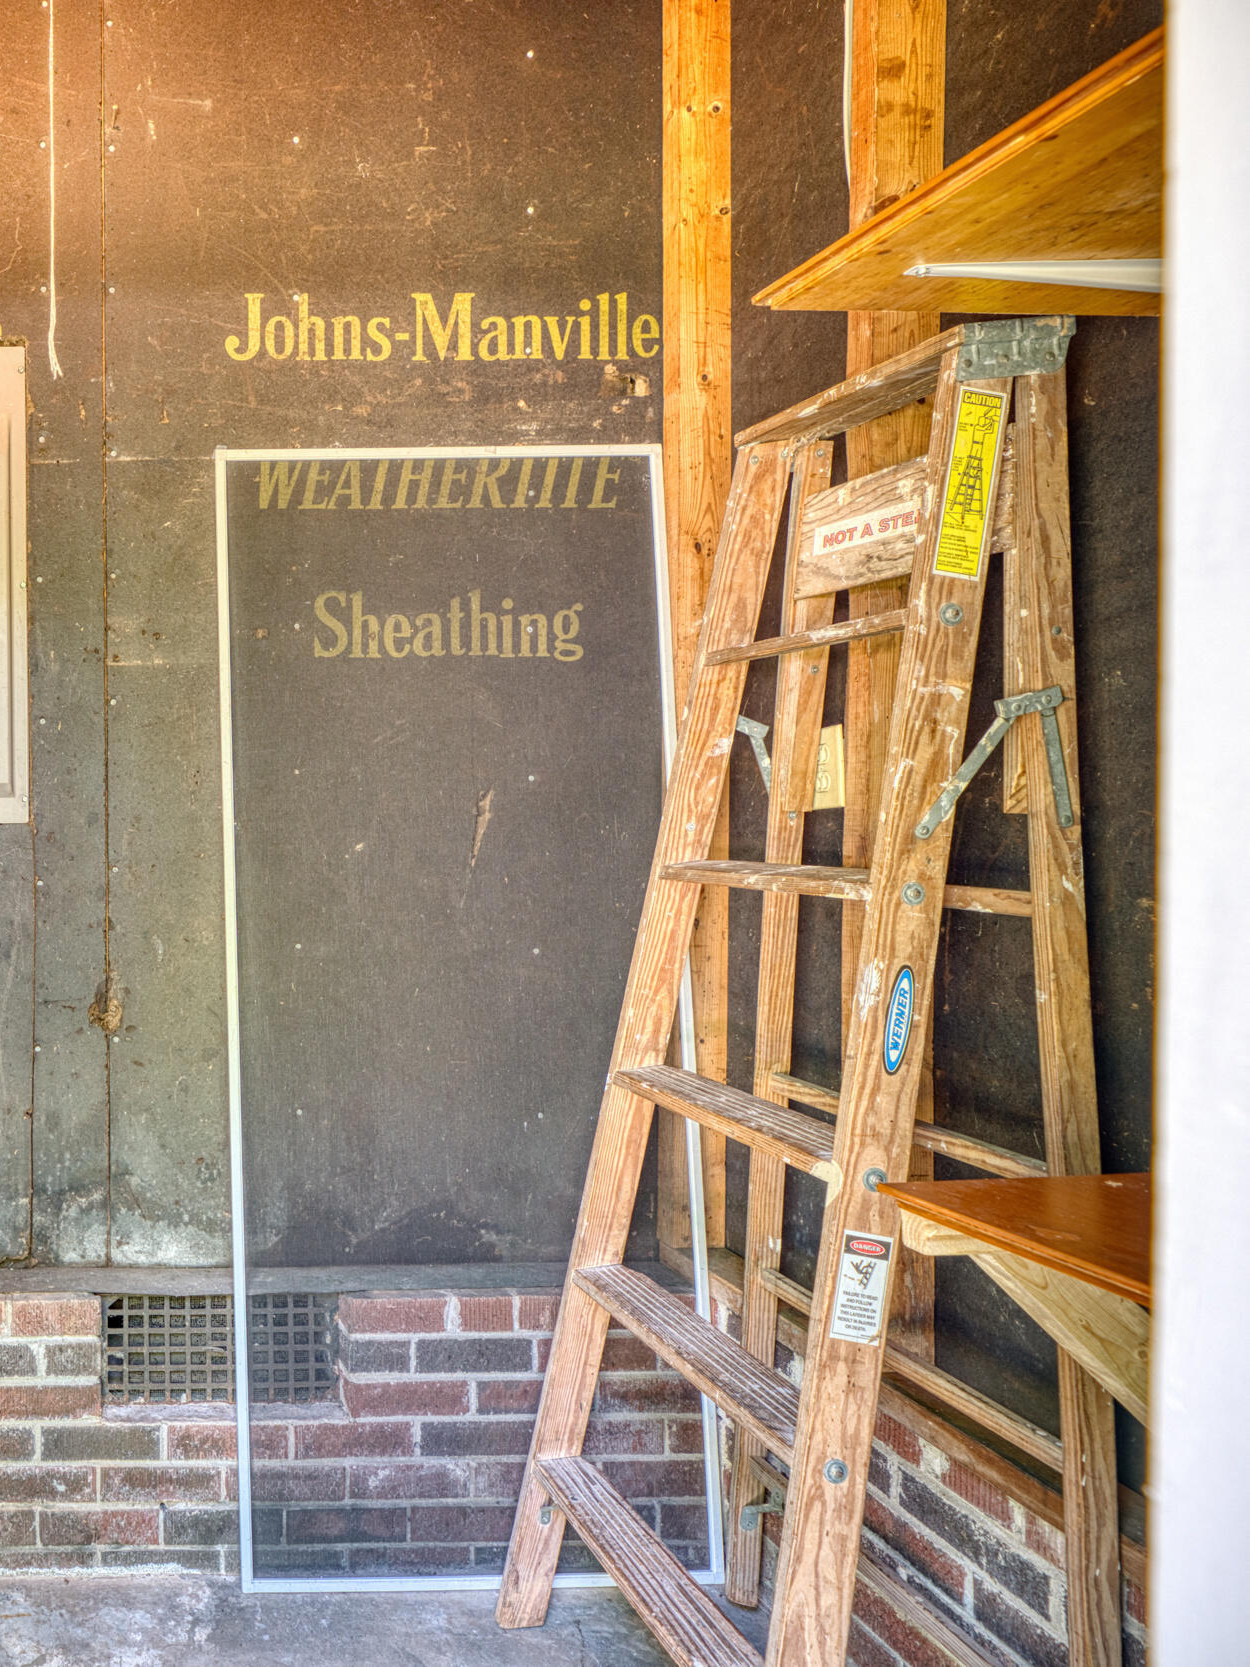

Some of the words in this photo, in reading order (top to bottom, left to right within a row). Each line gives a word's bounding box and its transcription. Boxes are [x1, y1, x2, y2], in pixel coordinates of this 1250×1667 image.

[224, 291, 660, 363] Johns-Manville
[964, 391, 1001, 408] CAUTION
[254, 456, 623, 510] WEATHERTITE
[822, 526, 858, 548] NOT
[860, 522, 874, 539] A
[313, 588, 584, 662] Sheathing
[890, 987, 910, 1051] WERNER
[853, 1242, 882, 1254] DANGER
